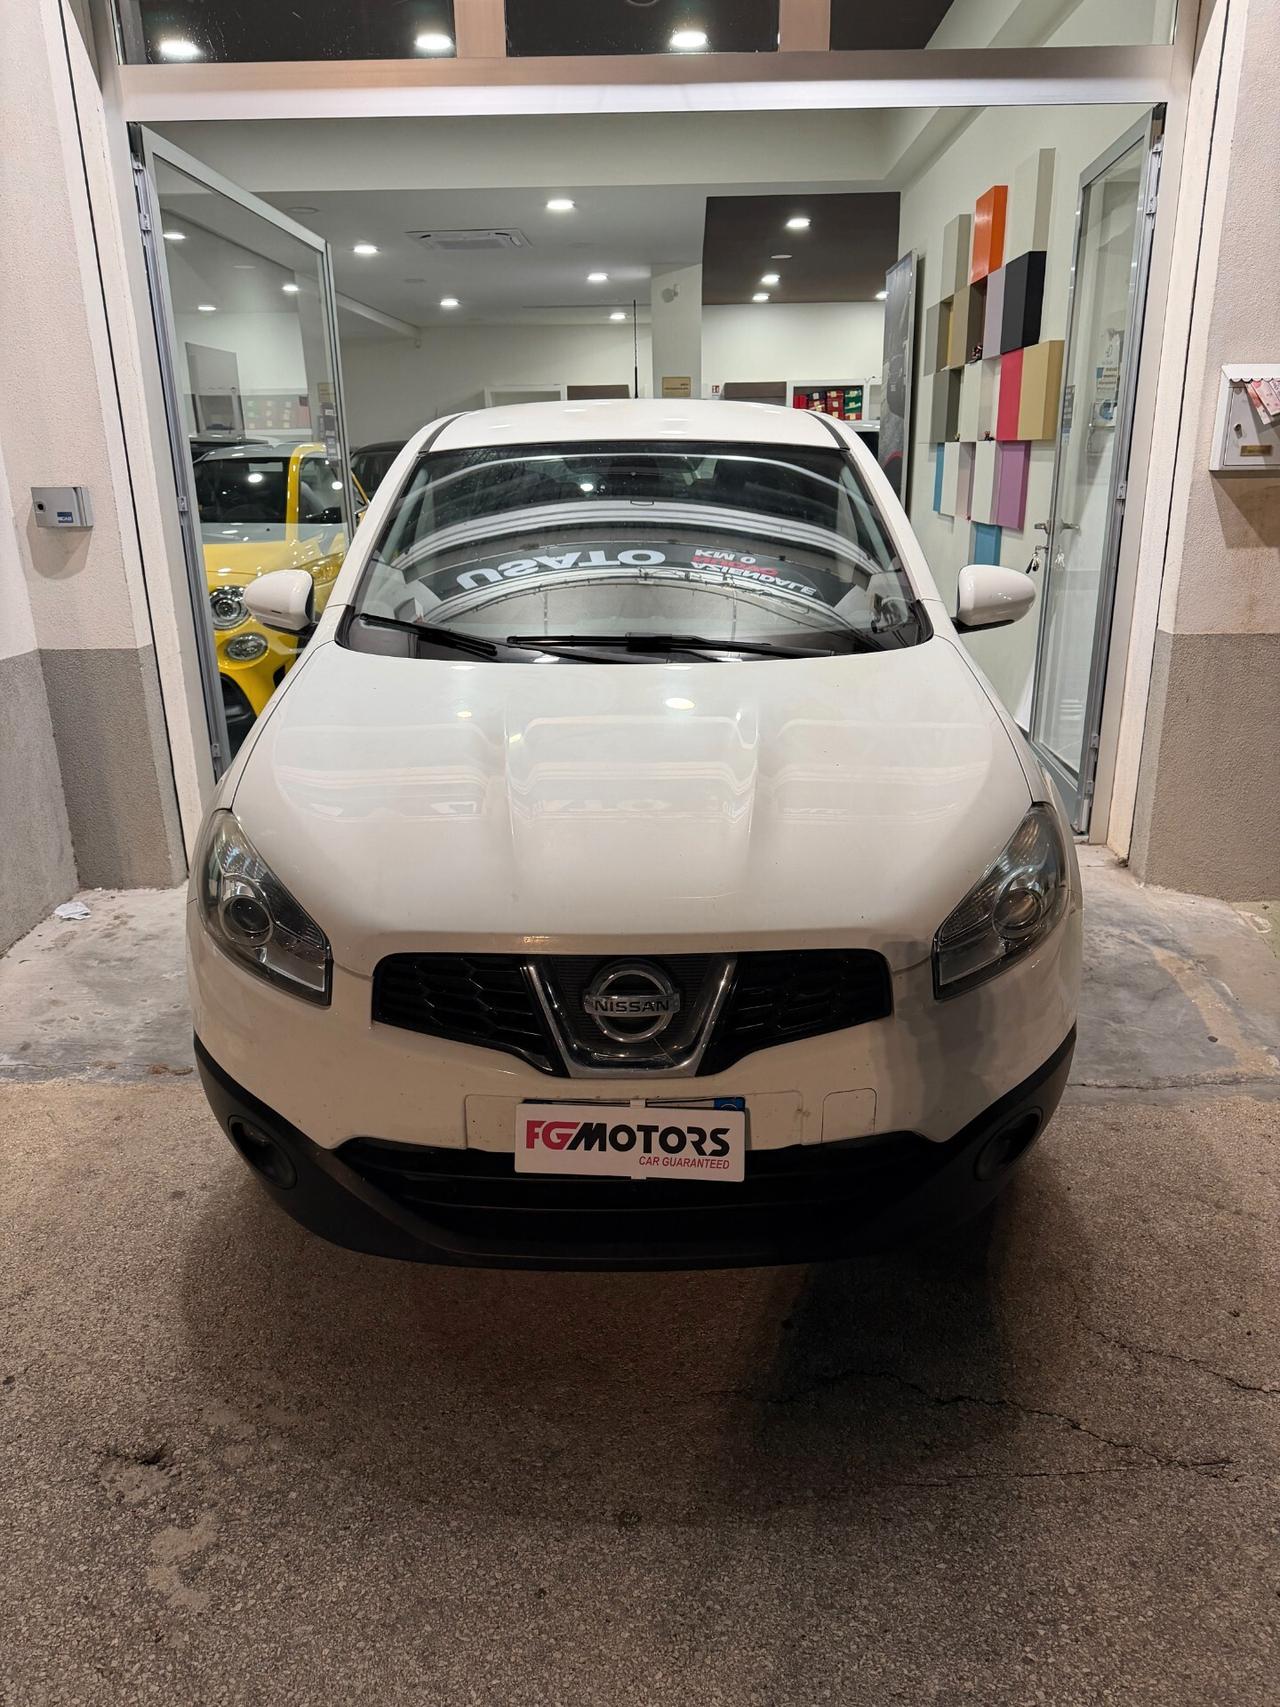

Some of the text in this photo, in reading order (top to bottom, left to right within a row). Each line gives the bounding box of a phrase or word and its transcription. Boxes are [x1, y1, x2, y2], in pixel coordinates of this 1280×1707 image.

[594, 1000, 669, 1013] NISSAN
[638, 1155, 731, 1170] CAR GUARANTEED
